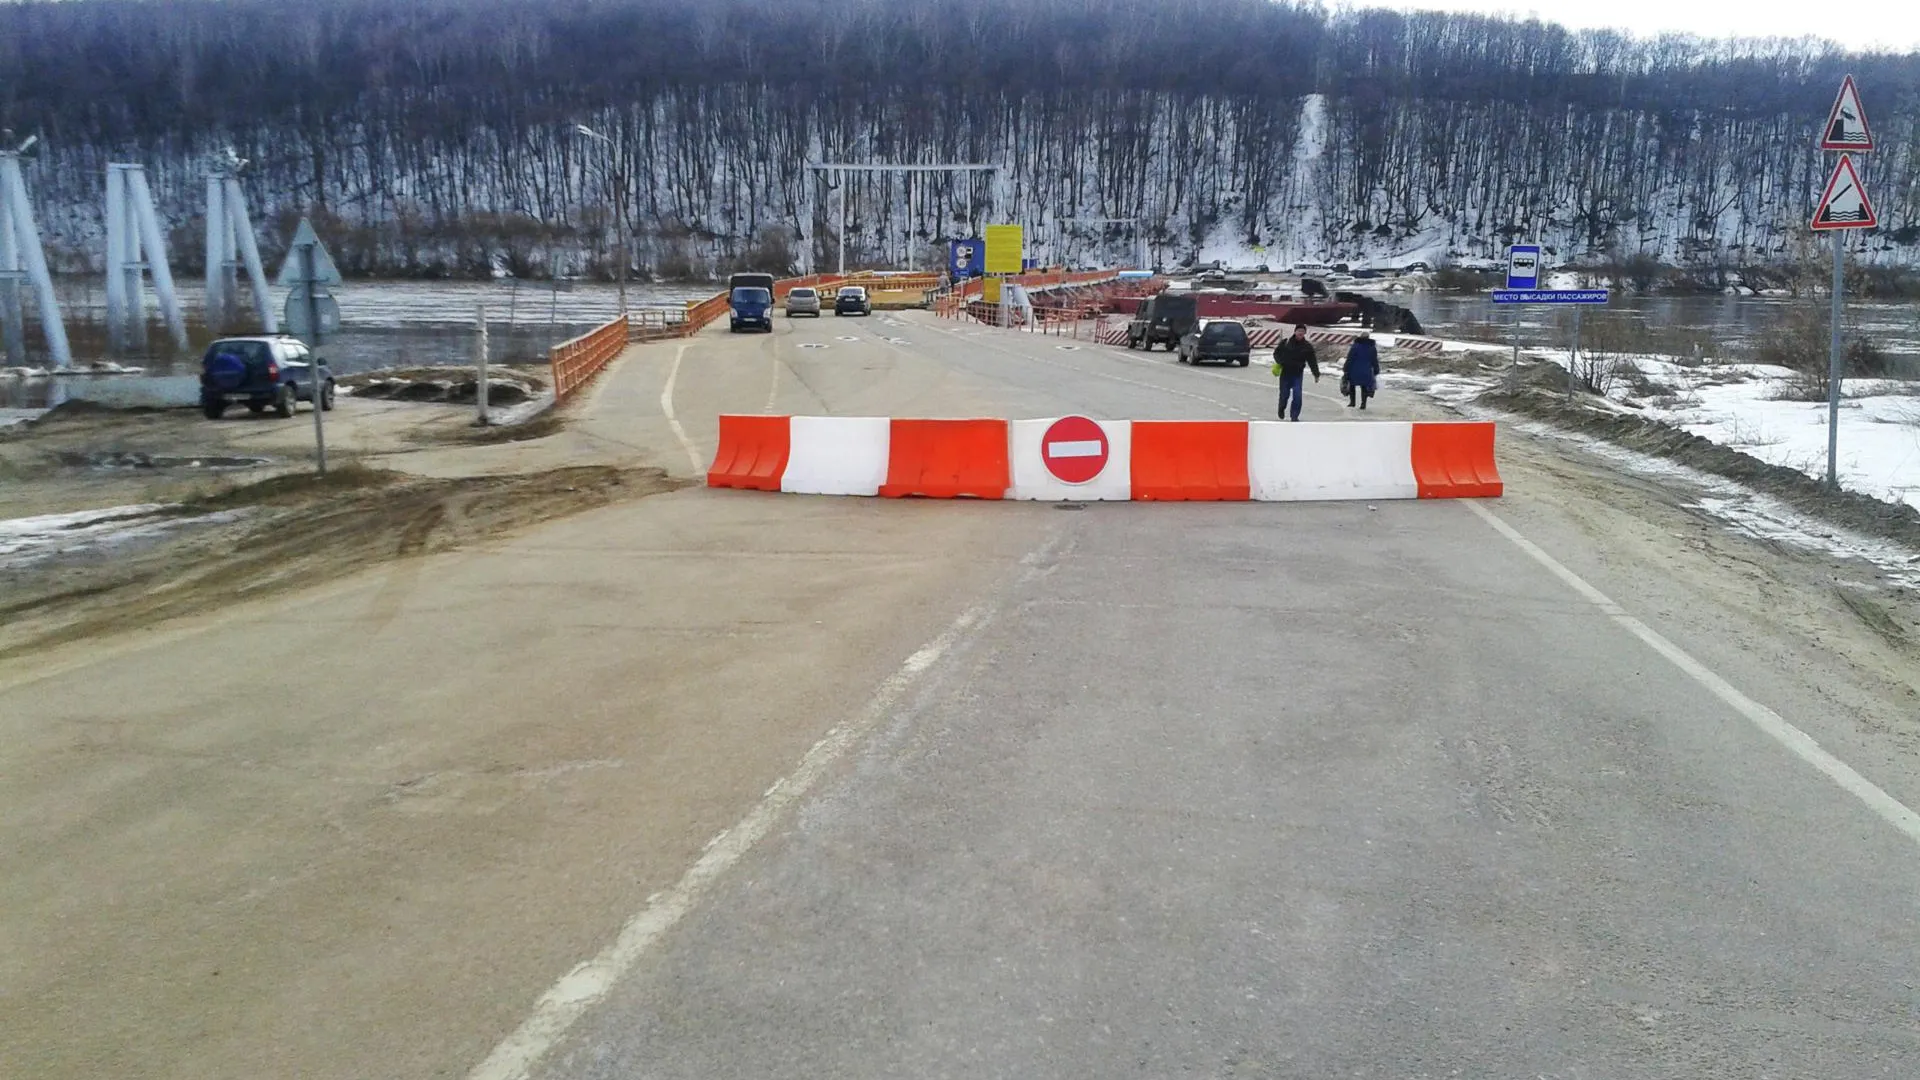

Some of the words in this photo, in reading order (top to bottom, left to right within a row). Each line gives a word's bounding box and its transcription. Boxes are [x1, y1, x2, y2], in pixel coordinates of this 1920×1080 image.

[1493, 293, 1519, 301] МЕСТО
[1520, 293, 1556, 302] ВЫСАДКИ
[1557, 293, 1607, 301] ПАССАЖИРОВ
